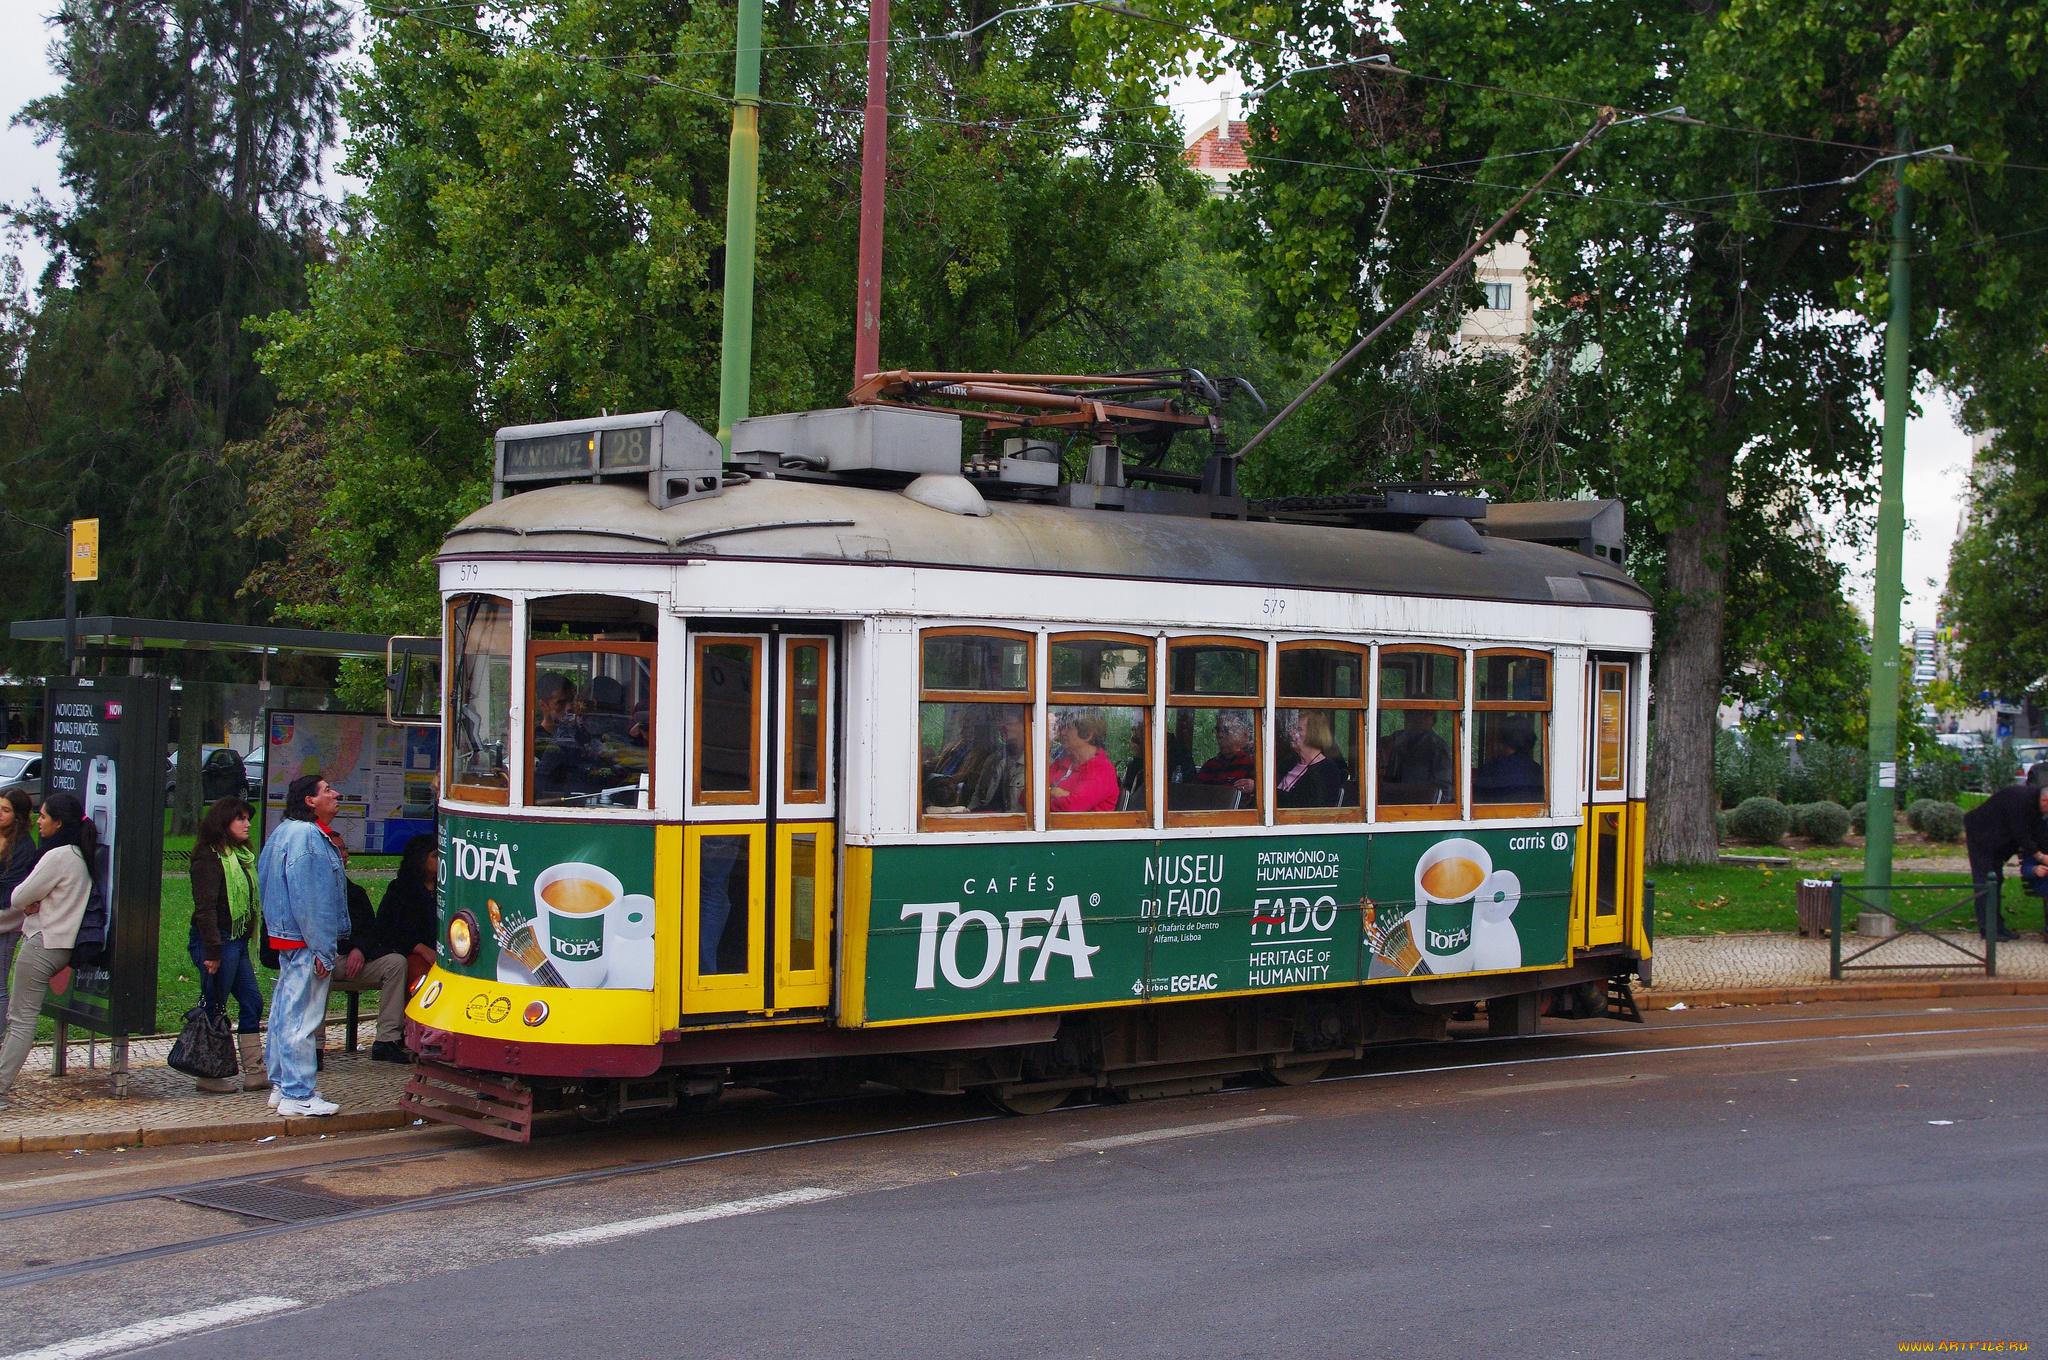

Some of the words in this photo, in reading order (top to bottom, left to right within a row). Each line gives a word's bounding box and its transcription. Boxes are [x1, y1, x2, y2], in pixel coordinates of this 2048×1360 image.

[612, 429, 644, 464] 28
[460, 564, 478, 581] 579
[1262, 599, 1286, 614] 579
[56, 704, 72, 716] NOVO
[73, 704, 93, 717] DESIGN.
[54, 722, 73, 735] NOVAS
[54, 739, 61, 752] DE
[54, 755, 61, 770] SÓ
[61, 758, 81, 772] MESMO
[53, 776, 58, 788] O
[1509, 832, 1546, 850] carris
[452, 837, 520, 886] TOFA
[1257, 848, 1326, 865] PATRIMÓNIO
[1328, 853, 1339, 862] DA
[1144, 854, 1224, 885] MUSEU
[1256, 864, 1339, 881] HUMANIDADE
[963, 872, 1055, 894] CAFÉS
[1166, 887, 1221, 917] FADO
[1250, 895, 1338, 936] FADO
[1157, 923, 1185, 932] Chafariz
[1186, 922, 1195, 931] de
[1196, 921, 1220, 930] Dentro
[552, 936, 601, 956] TOFA
[900, 894, 1101, 991] TOFA
[1153, 934, 1180, 944] Alfama,
[1180, 933, 1202, 942] Lisboa
[1427, 928, 1470, 949] TOFA
[1249, 949, 1314, 967] HERITAGE
[1317, 951, 1331, 962] OF
[1170, 973, 1218, 993] EGEAC
[1249, 965, 1330, 986] HUMANITY
